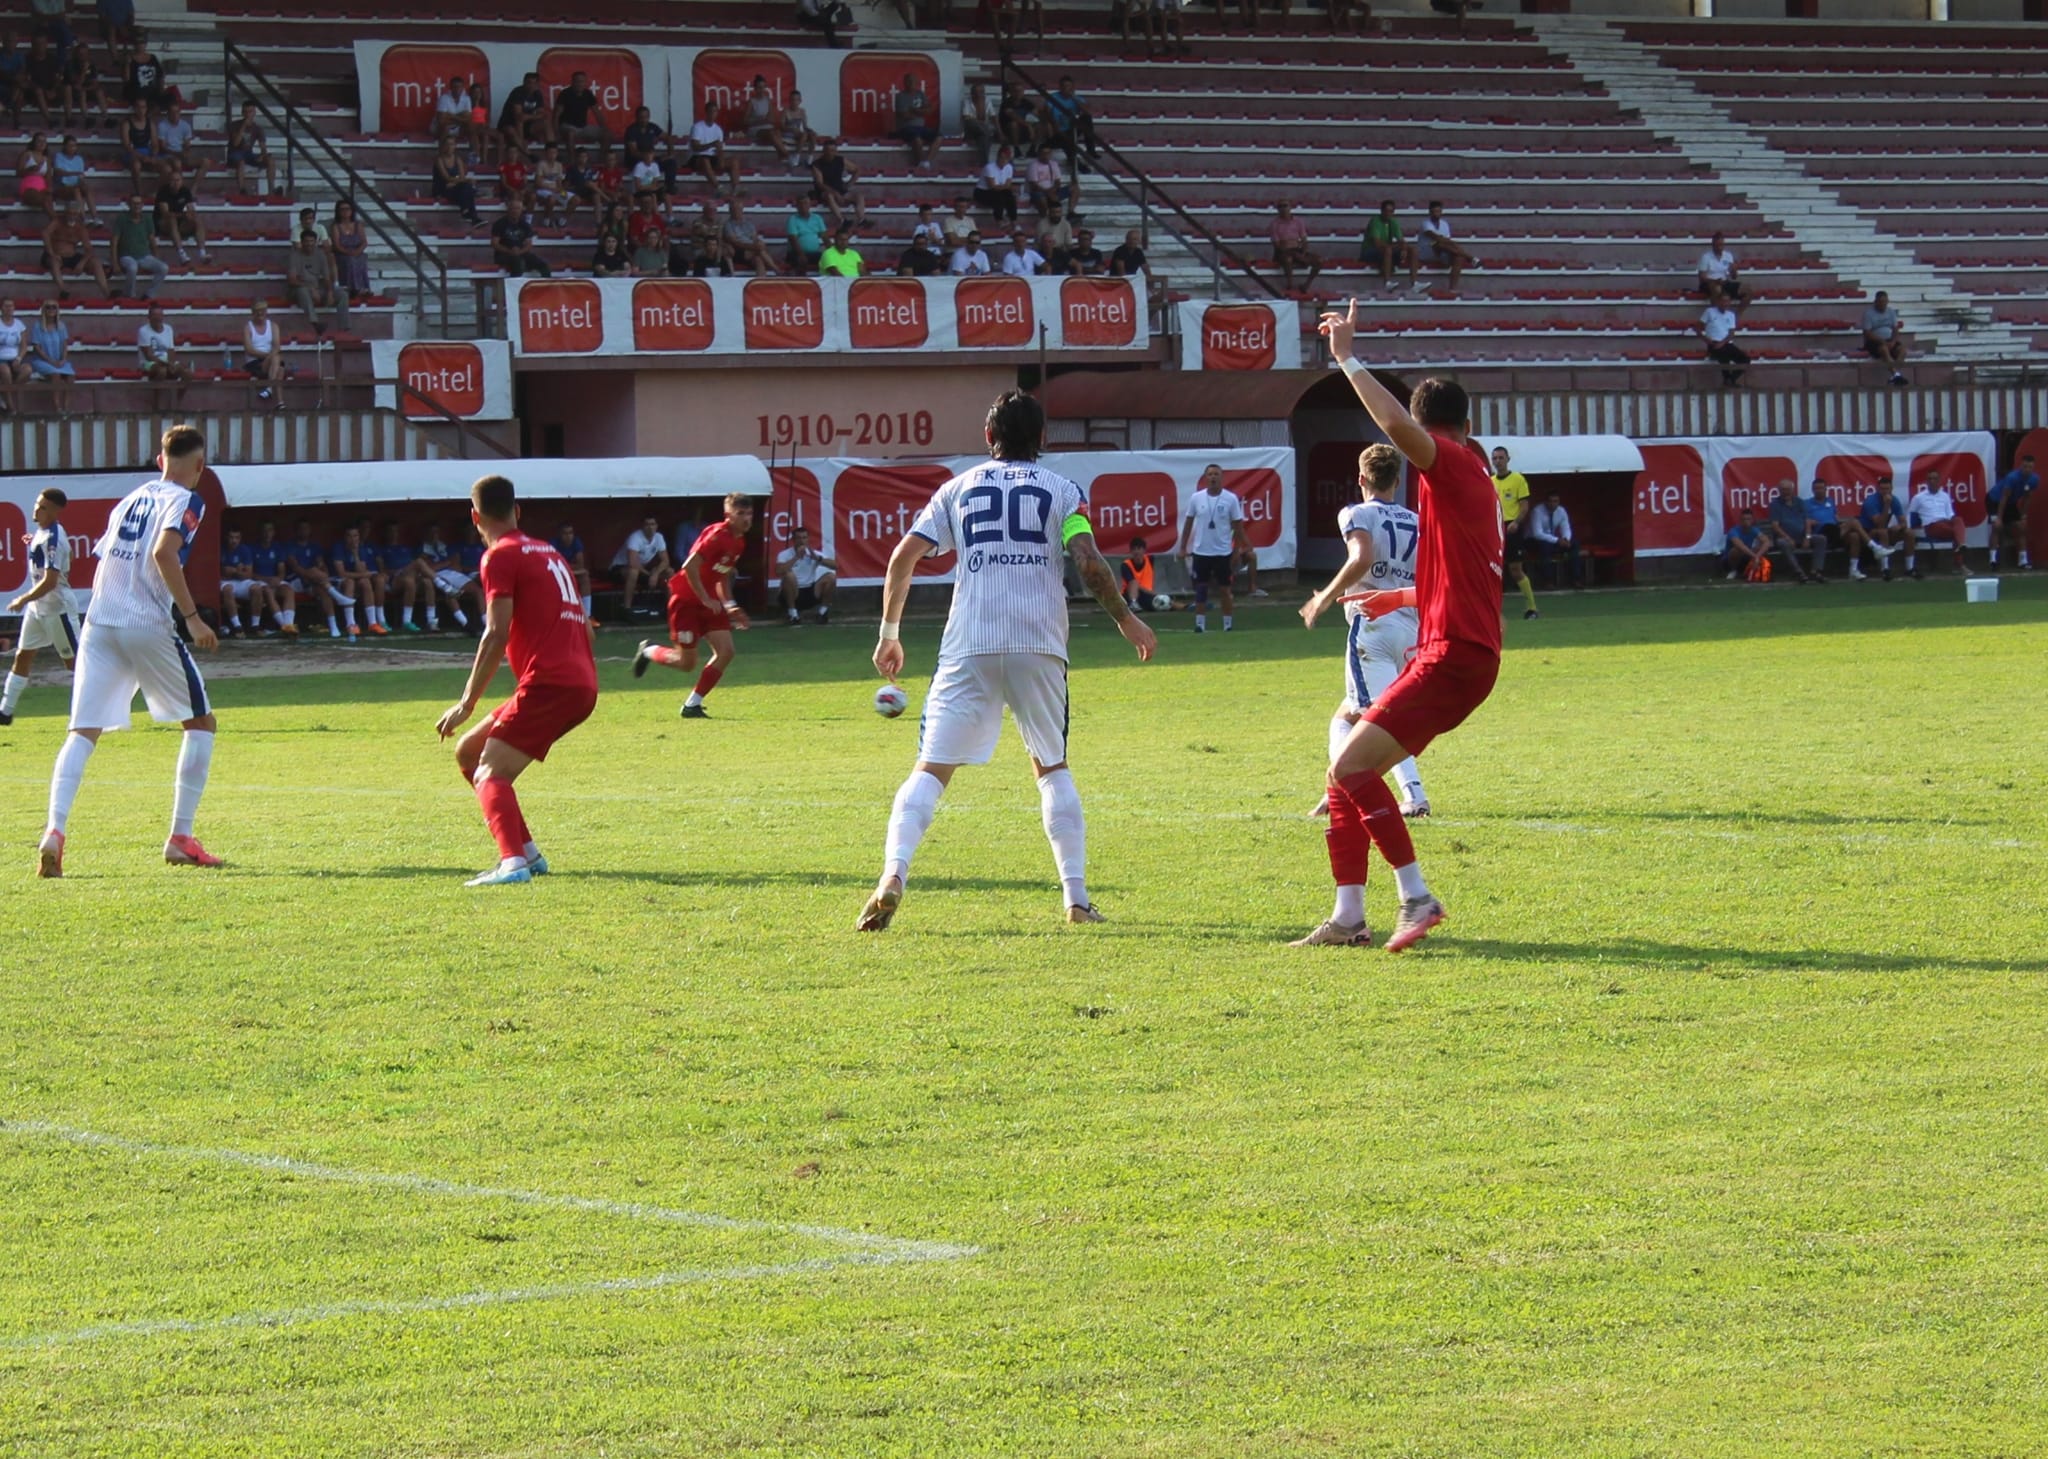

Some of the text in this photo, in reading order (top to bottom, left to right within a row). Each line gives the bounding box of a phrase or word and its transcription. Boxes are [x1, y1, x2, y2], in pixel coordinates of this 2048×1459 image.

[528, 300, 593, 329] m:tel
[641, 300, 705, 328] m:tel
[752, 299, 814, 326] m:tel
[857, 298, 918, 326] m:tel
[965, 297, 1025, 324] m:tel
[1069, 297, 1128, 323] m:tel
[1209, 323, 1269, 350] m:tel
[408, 364, 473, 392] m:tel
[1003, 469, 1039, 481] BSK
[118, 494, 155, 541] 9
[960, 485, 1053, 547] 20
[1100, 495, 1167, 528] m:tel
[1382, 519, 1417, 562] 17
[988, 553, 1049, 567] MOZZART
[547, 558, 580, 606] 11
